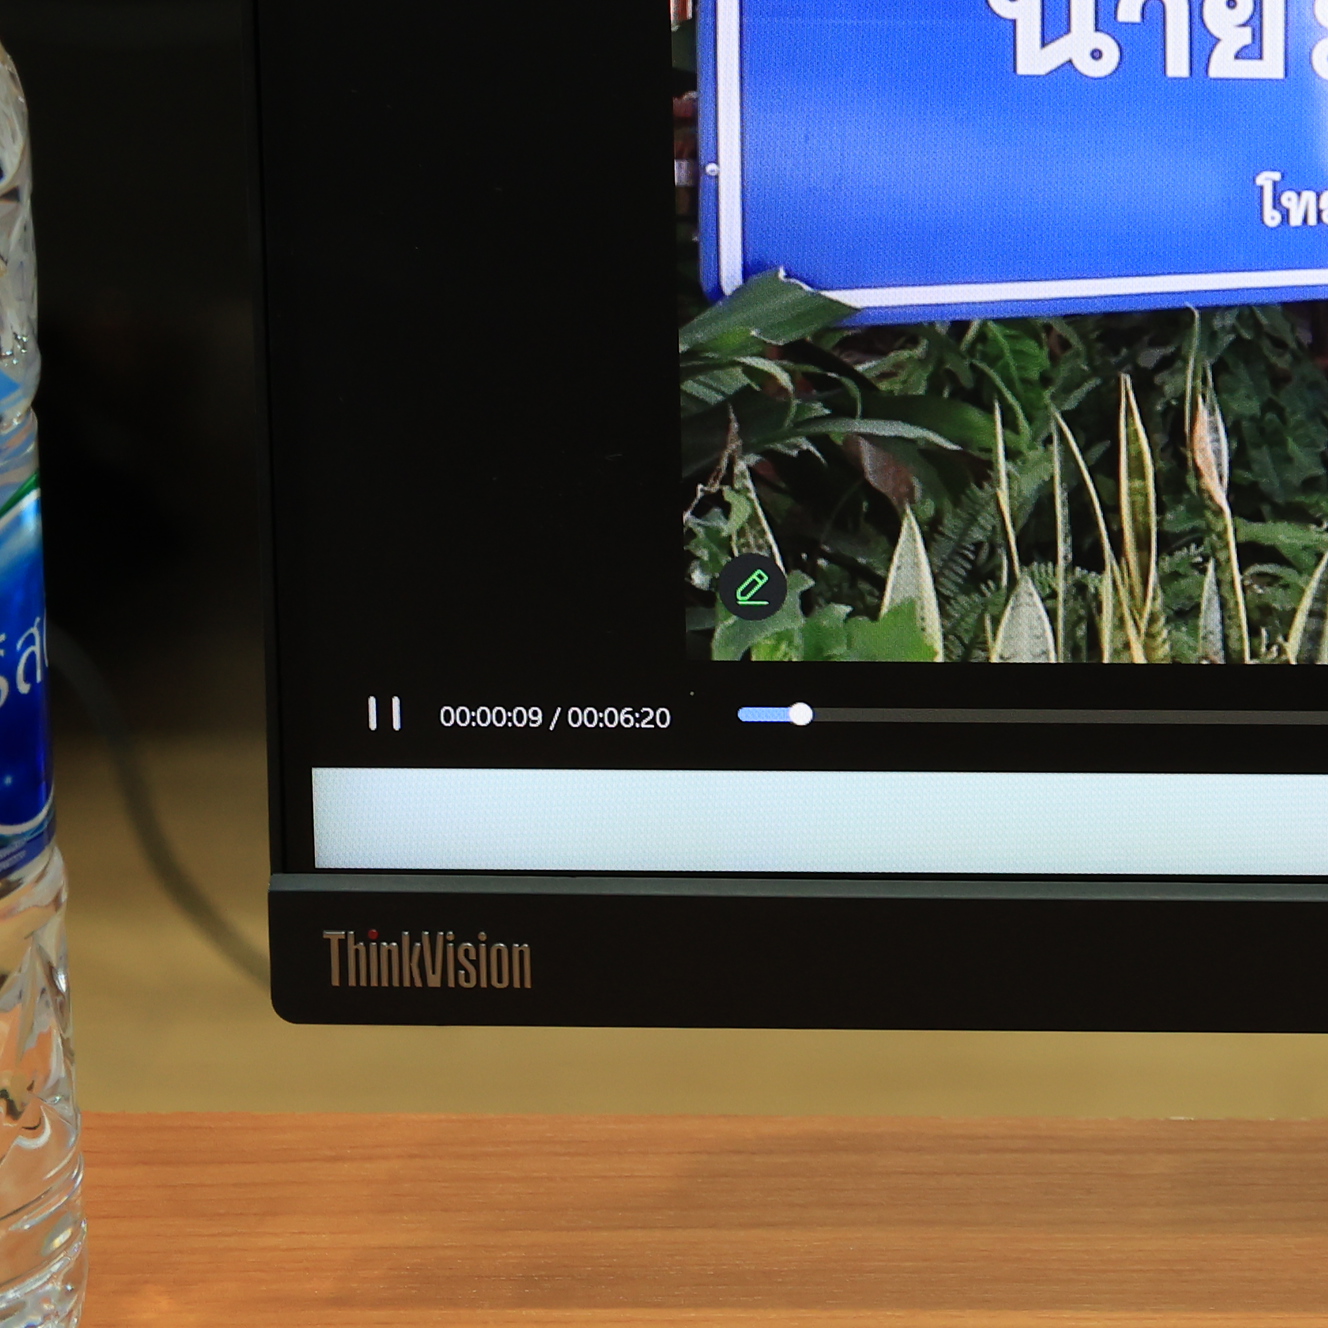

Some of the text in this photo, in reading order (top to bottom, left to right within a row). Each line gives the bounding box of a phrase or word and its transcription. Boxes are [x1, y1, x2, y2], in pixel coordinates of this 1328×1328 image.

[440, 705, 543, 728] 00:00:09
[567, 706, 671, 729] 00:06:20
[323, 928, 533, 989] ThinkVision
